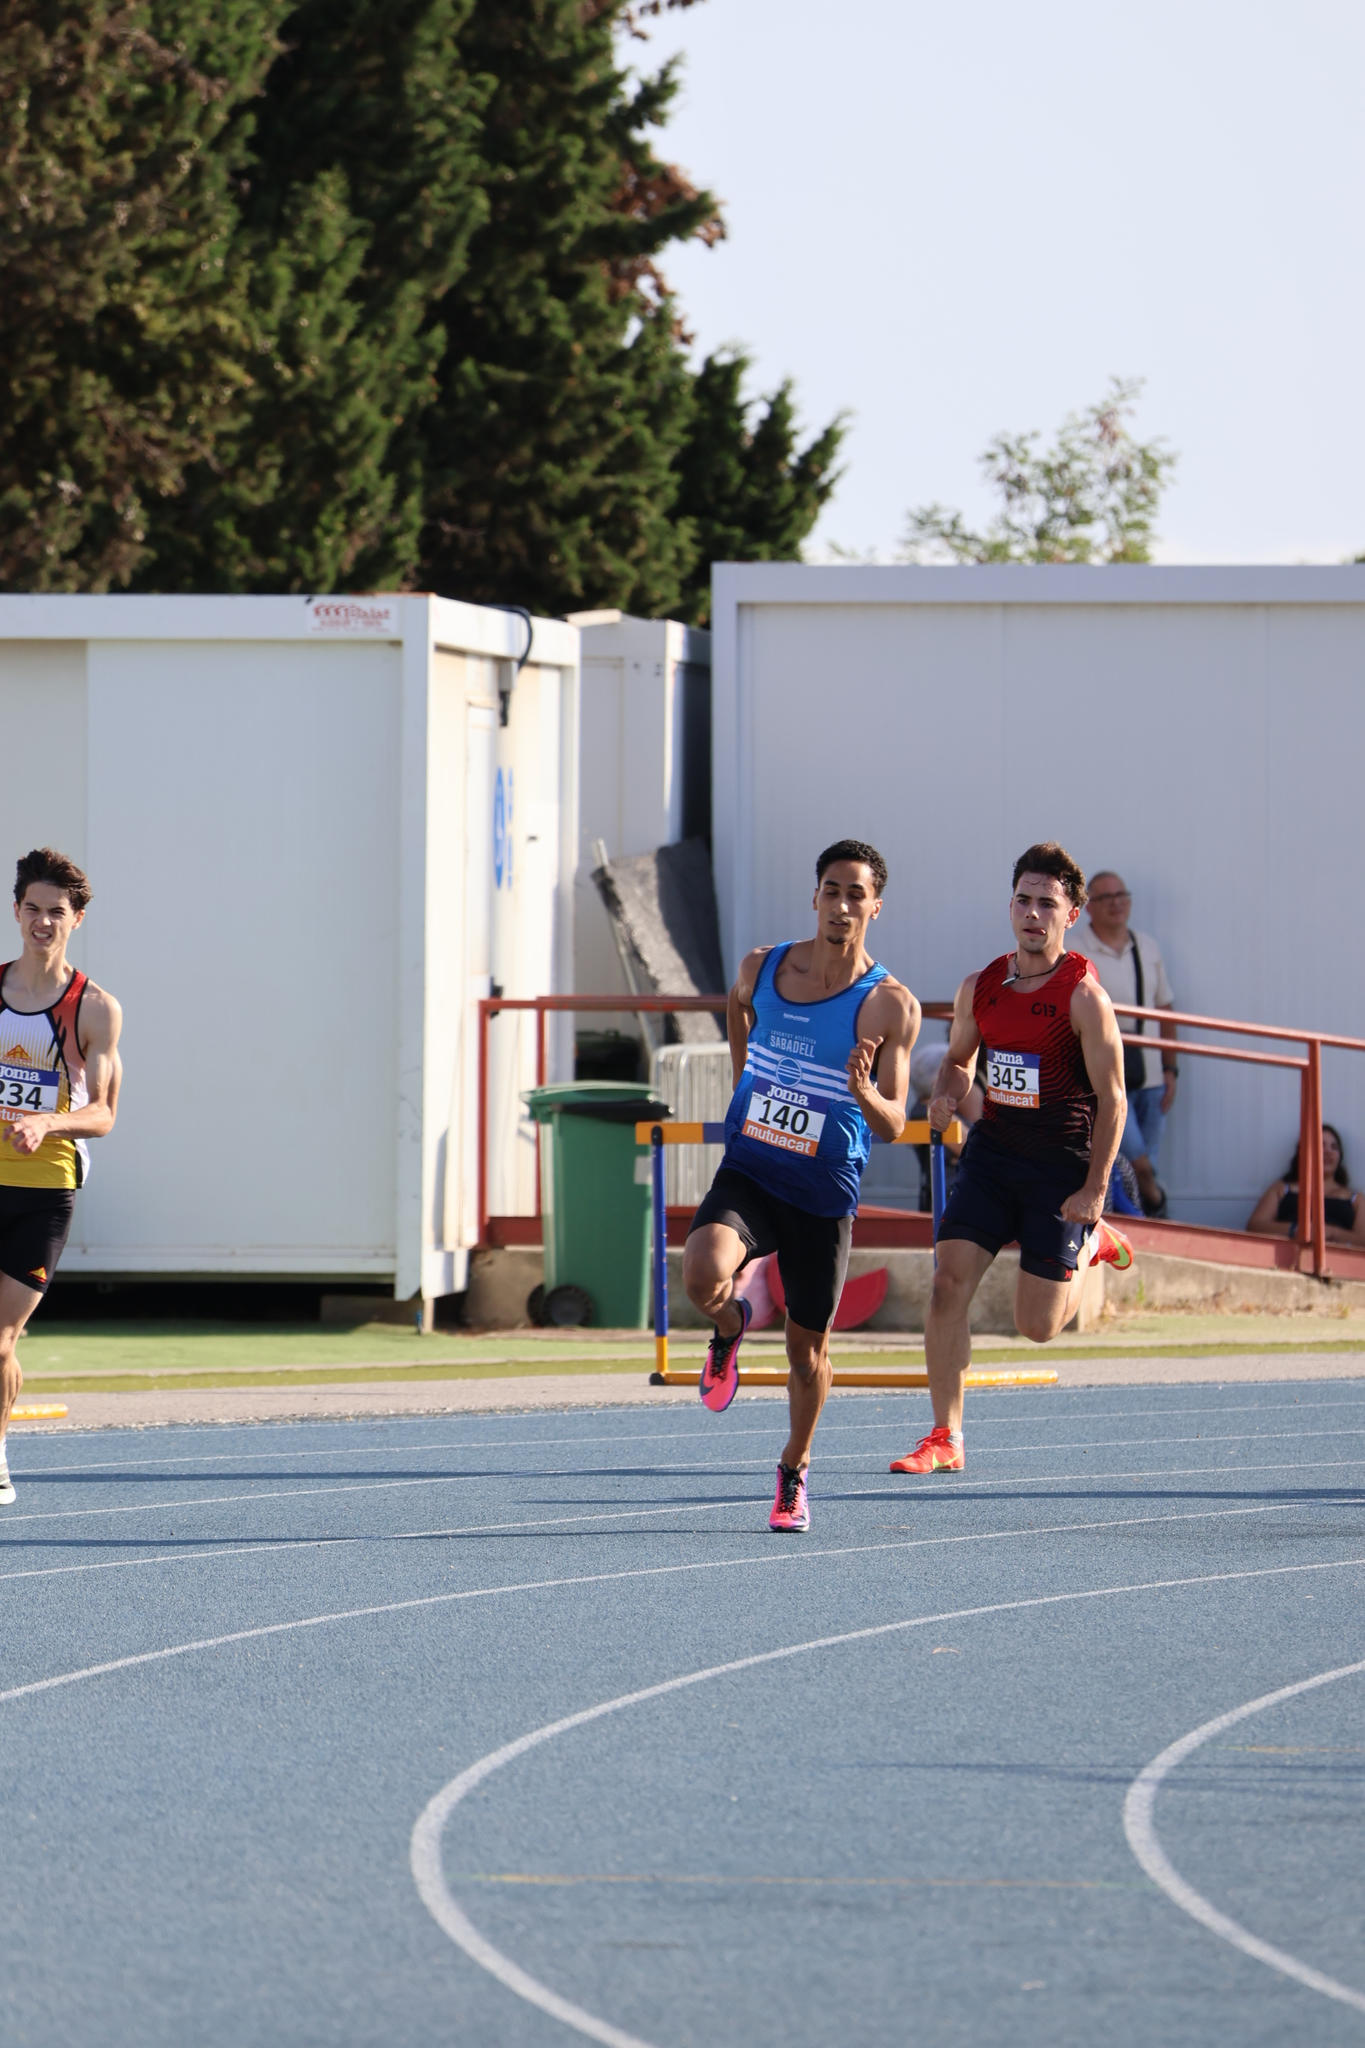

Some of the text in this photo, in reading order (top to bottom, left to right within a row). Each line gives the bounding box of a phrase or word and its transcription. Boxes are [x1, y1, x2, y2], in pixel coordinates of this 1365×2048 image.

[770, 1035, 815, 1058] SABADELL
[992, 1064, 1027, 1091] 345
[766, 1084, 810, 1107] Joma
[758, 1099, 810, 1135] 140
[746, 1124, 811, 1154] mutuacat
